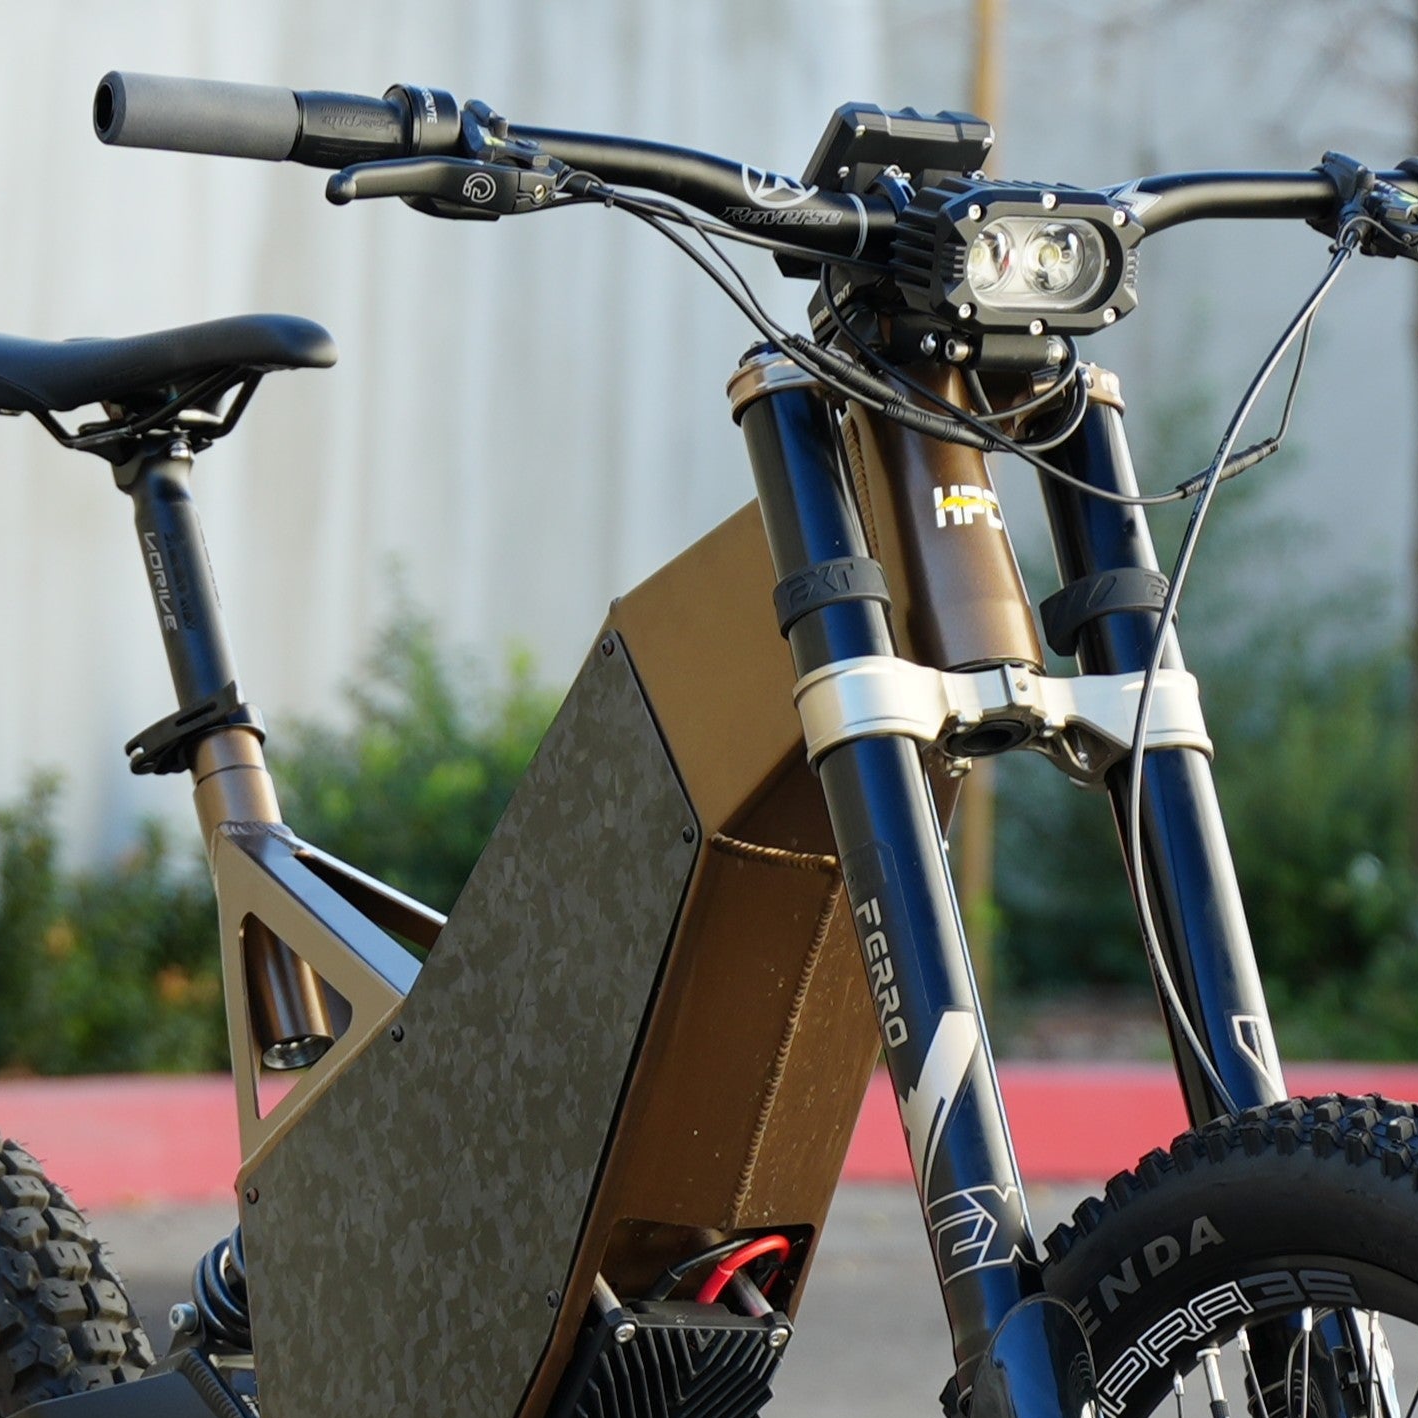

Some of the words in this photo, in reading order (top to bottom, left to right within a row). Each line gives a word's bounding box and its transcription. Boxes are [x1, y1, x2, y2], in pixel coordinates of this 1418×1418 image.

[719, 206, 843, 226] Reverse
[933, 484, 1003, 530] HPC
[855, 897, 909, 1049] FERRO
[1075, 1215, 1227, 1337] ENDA
